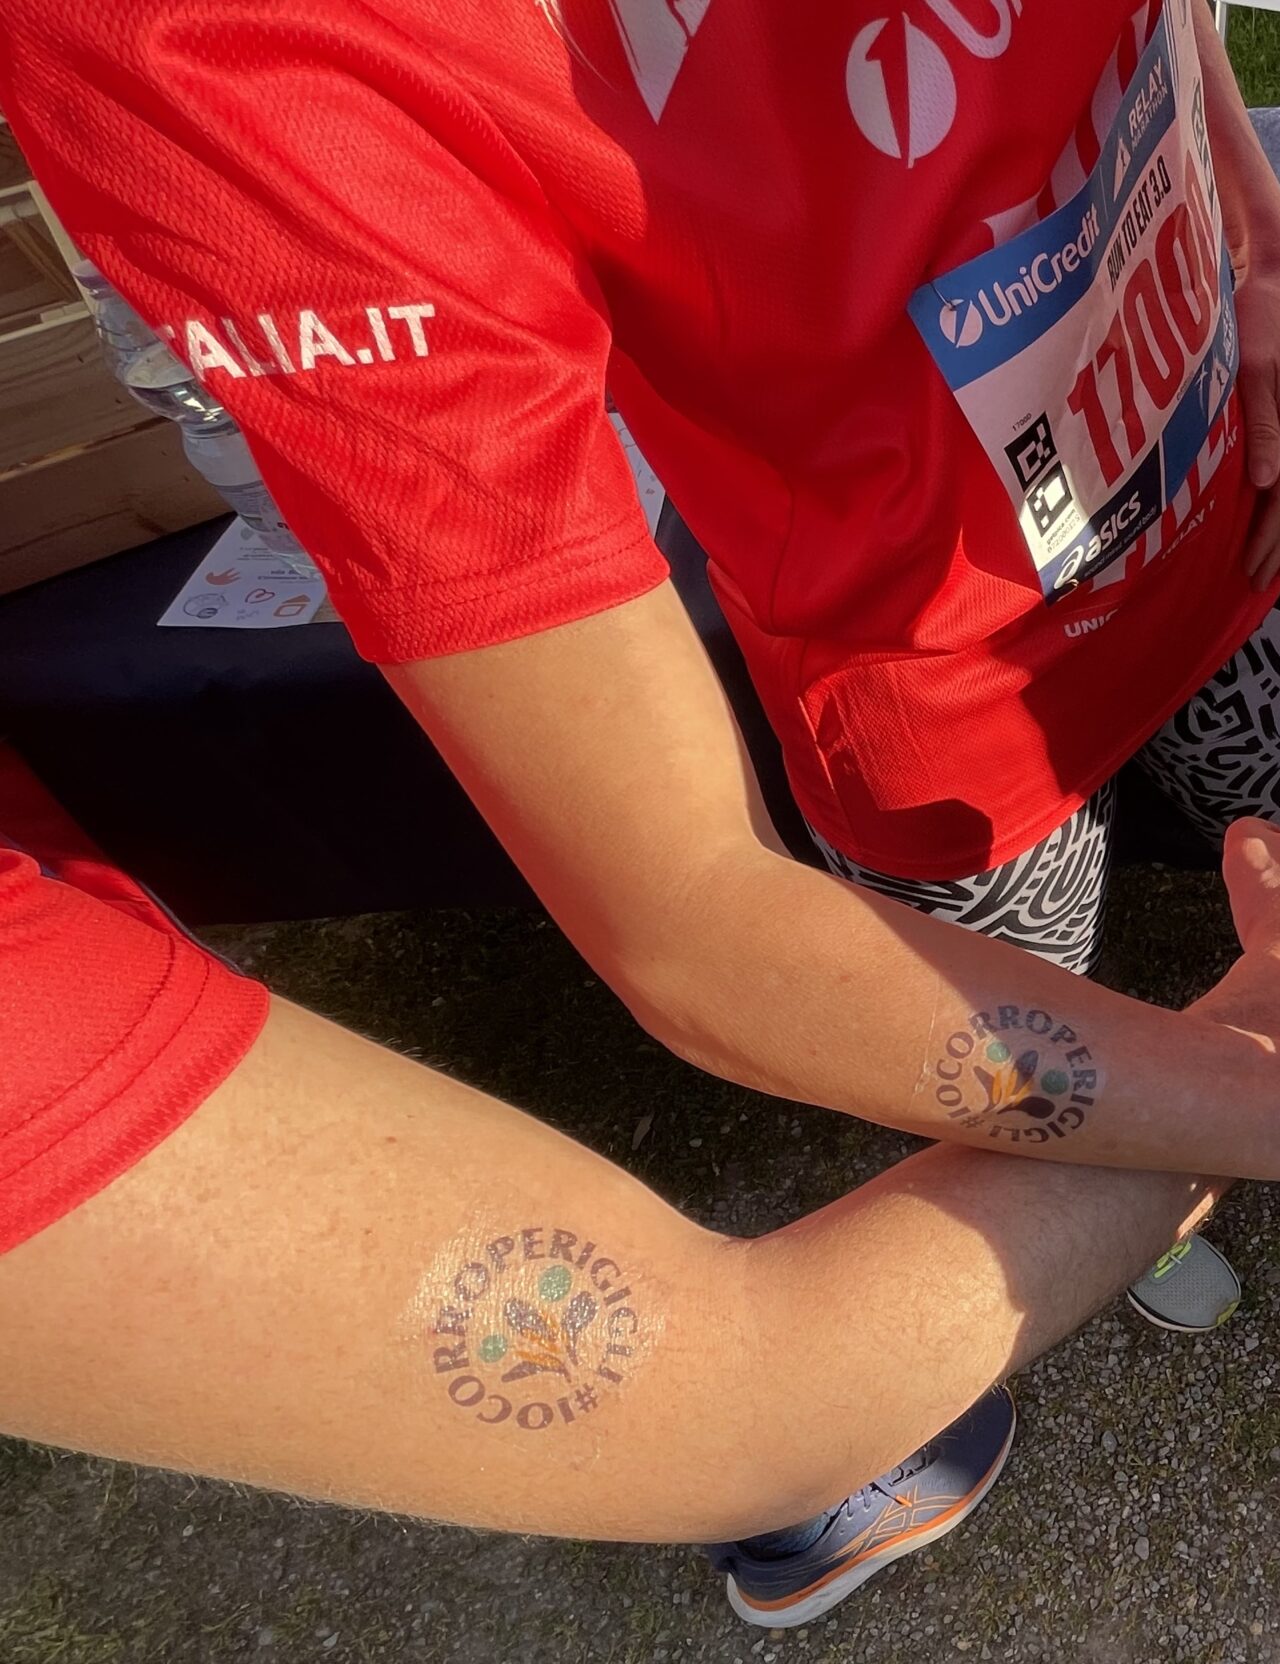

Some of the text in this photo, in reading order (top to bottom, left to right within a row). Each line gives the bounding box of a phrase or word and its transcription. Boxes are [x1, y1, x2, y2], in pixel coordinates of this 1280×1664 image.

[1127, 55, 1163, 138] RELAY
[1130, 83, 1168, 152] MARATHON
[977, 202, 1101, 327] UniCredit
[1106, 154, 1172, 293] RUN TO EAT 3.0
[165, 303, 437, 383] ALIA.IT
